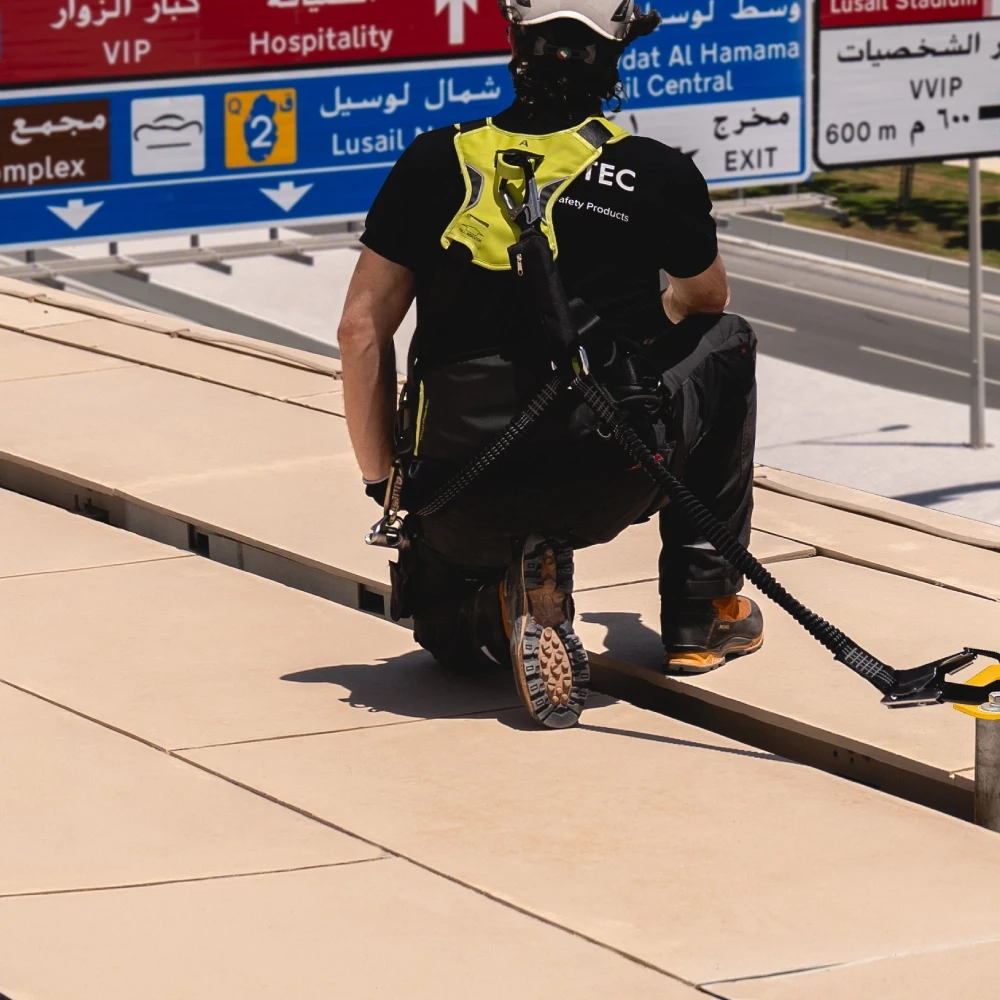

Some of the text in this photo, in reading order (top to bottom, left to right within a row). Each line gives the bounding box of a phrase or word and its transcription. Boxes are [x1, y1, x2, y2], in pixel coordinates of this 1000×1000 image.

[103, 39, 151, 65] VIP
[249, 25, 393, 57] Hospitality
[837, 31, 980, 67] الشخصيات
[617, 41, 800, 71] dat Al Hamama
[319, 76, 501, 118] شمال لوسيل
[647, 70, 734, 97] Central
[910, 76, 963, 100] VVIP
[227, 96, 242, 116] Q
[10, 113, 106, 145] مجمع
[250, 115, 273, 148] 2
[713, 106, 790, 140] مخرج
[825, 121, 897, 145] 600 m
[332, 128, 405, 156] Lusail
[0, 155, 86, 185] mplex
[725, 147, 777, 171] EXIT
[558, 195, 629, 222] afety Products
